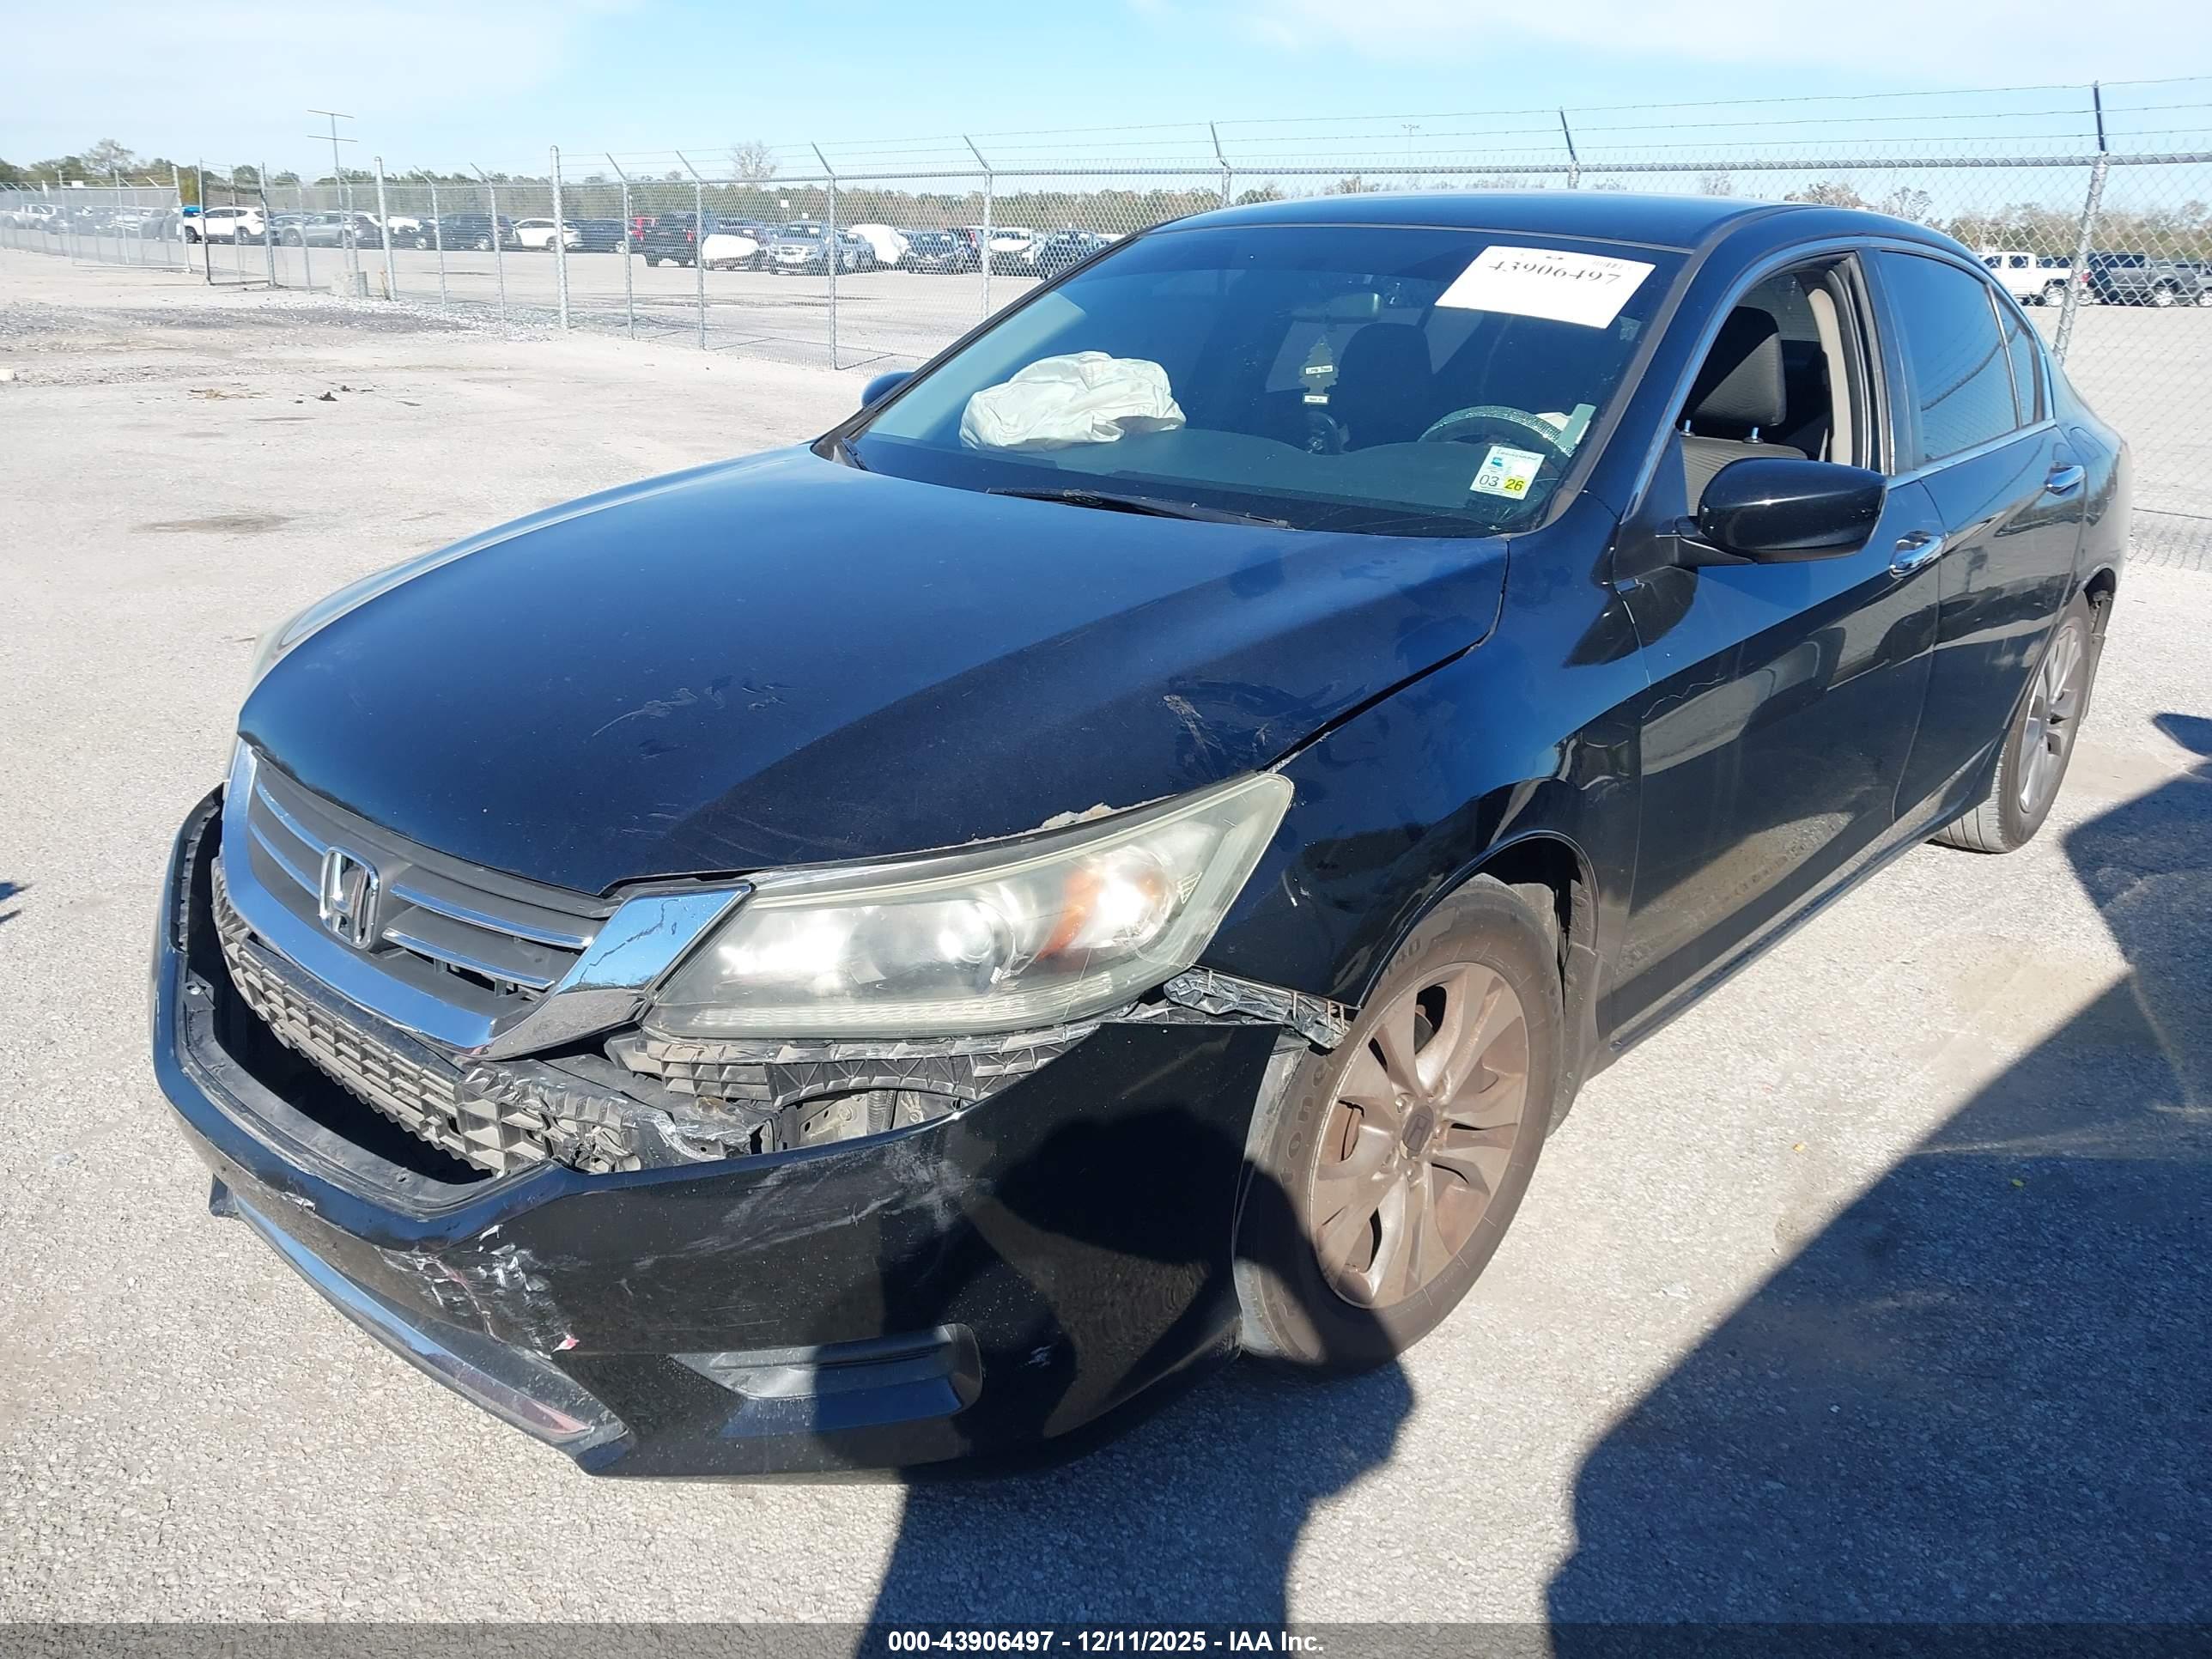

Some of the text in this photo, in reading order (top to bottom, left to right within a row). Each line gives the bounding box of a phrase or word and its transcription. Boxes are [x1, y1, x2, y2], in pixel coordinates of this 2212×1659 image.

[1488, 261, 1621, 284] 43906497
[1480, 475, 1524, 491] 03 26
